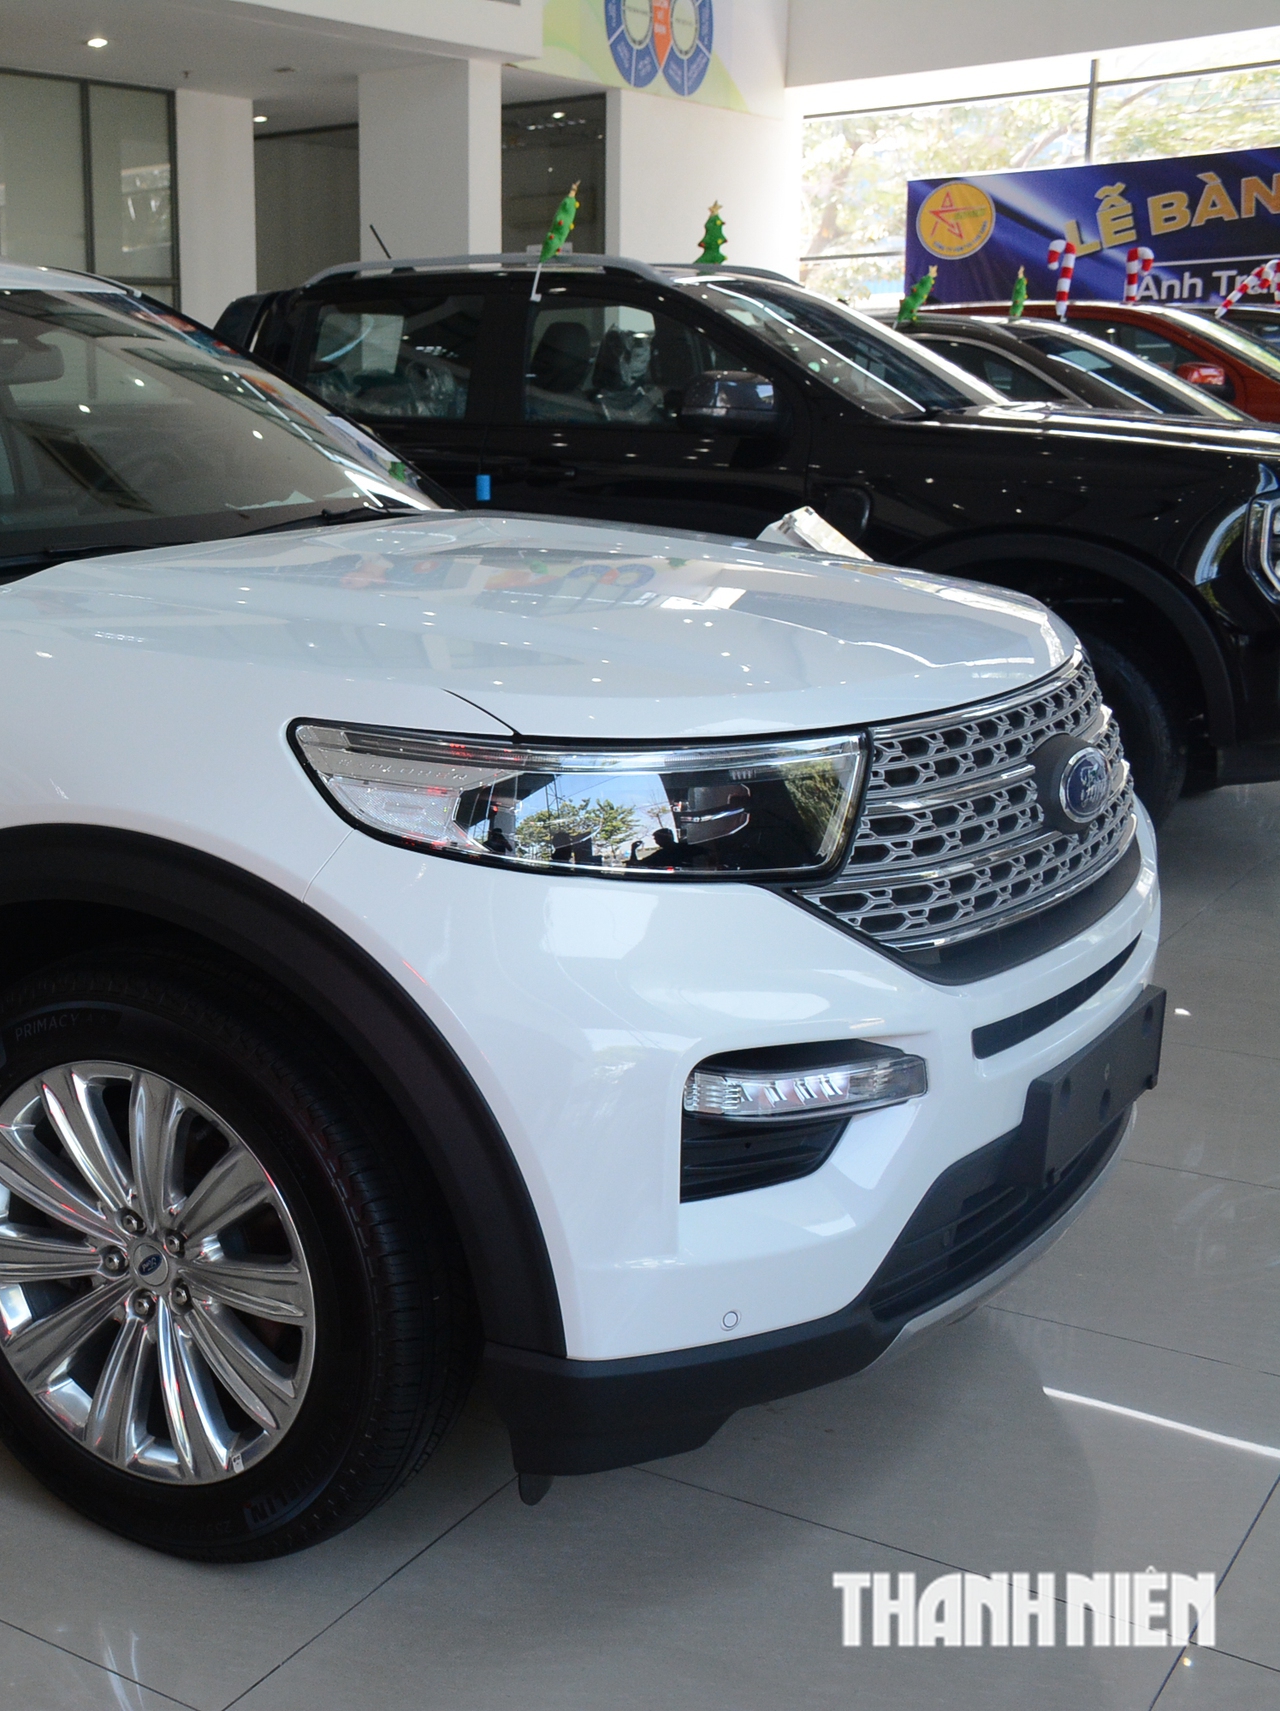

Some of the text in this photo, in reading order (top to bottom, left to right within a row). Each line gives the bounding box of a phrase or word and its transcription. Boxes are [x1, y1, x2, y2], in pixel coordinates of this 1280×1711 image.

[1064, 182, 1137, 258] LỄ
[1136, 272, 1203, 300] Anh
[15, 1013, 80, 1042] PRIMACY
